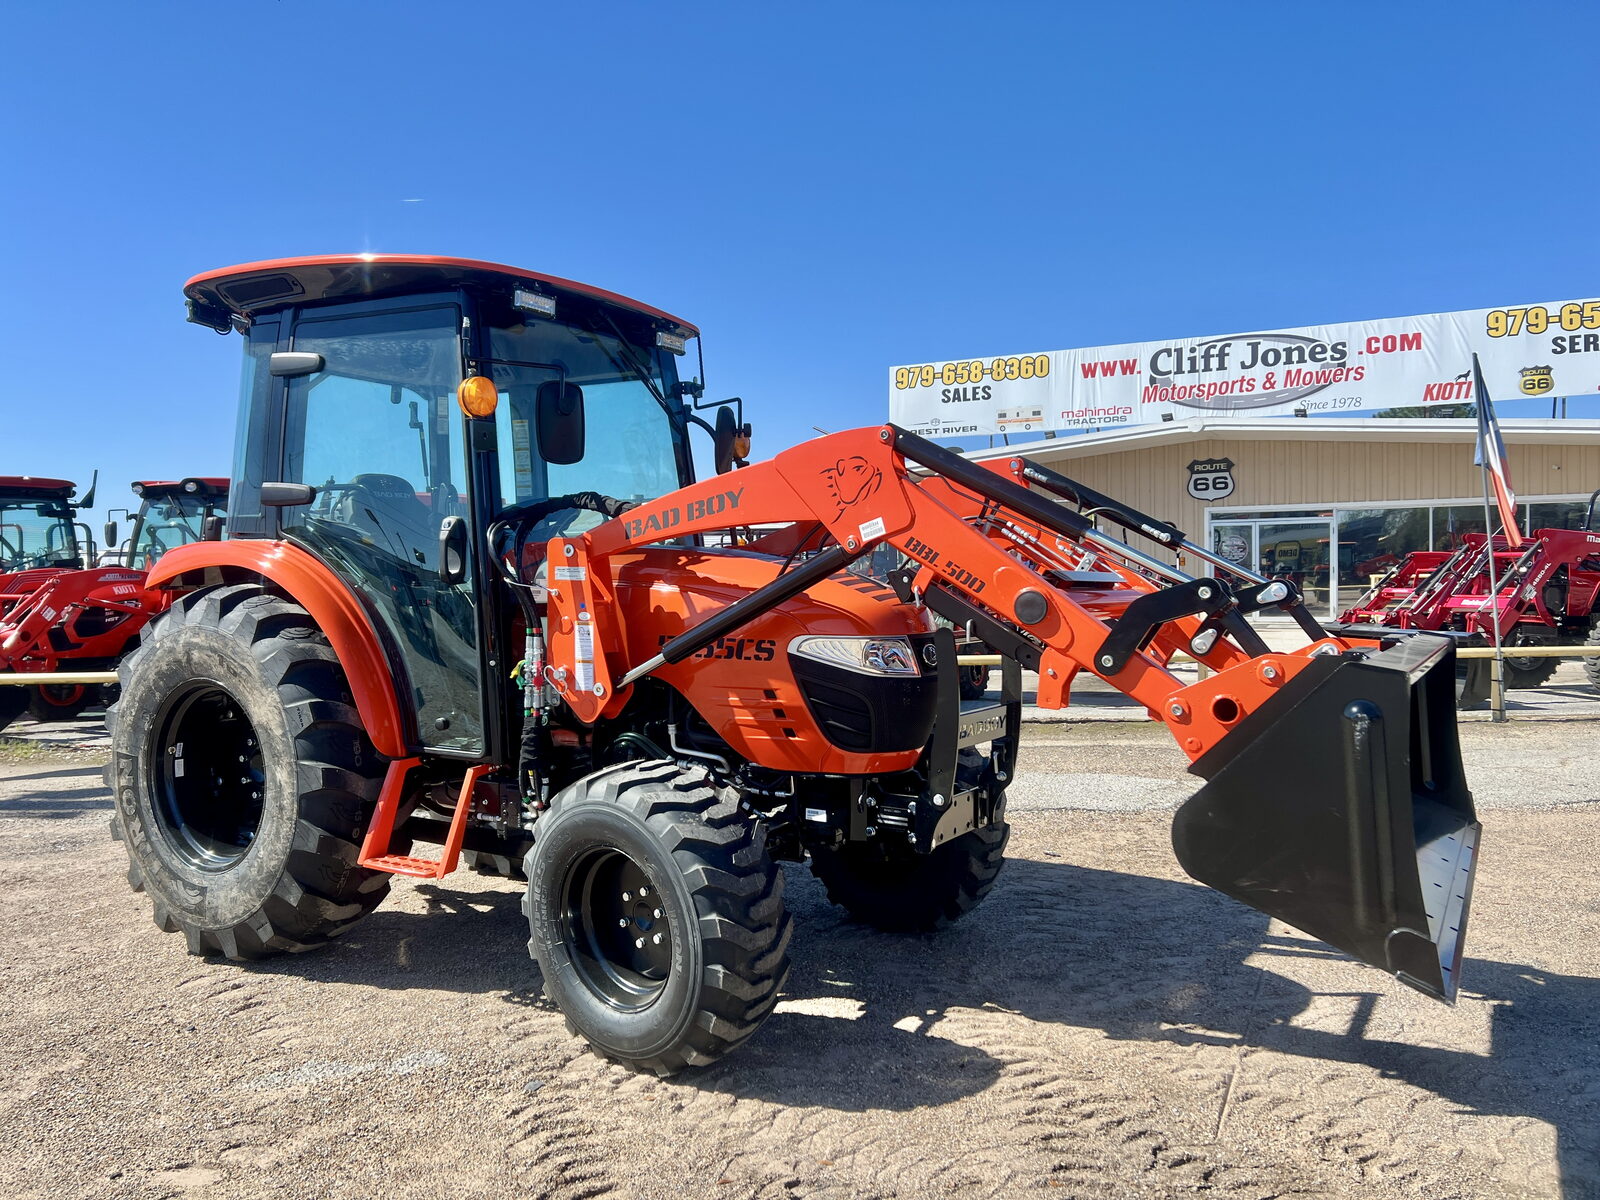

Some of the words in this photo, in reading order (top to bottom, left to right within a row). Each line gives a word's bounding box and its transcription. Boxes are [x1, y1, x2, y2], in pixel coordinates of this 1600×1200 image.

[1358, 333, 1422, 355] .COM
[1149, 343, 1232, 376] Cliff
[1240, 341, 1347, 369] Jones
[895, 355, 1050, 390] 979-658-8360
[1523, 368, 1549, 376] ROUTE
[1142, 376, 1257, 403] Motorsports
[1262, 372, 1277, 390] &
[1284, 366, 1365, 388] Mowers
[1422, 381, 1472, 401] KIOTI
[1523, 378, 1550, 390] 66
[941, 385, 992, 404] SALES
[1300, 399, 1328, 410] Since
[1332, 397, 1362, 409] 1978
[1061, 405, 1132, 418] mahindra
[1067, 414, 1127, 426] TRACTORS
[943, 425, 978, 434] RIVER
[1194, 462, 1228, 471] ROUTE
[1193, 476, 1229, 491] 66
[624, 507, 681, 540] BAD
[687, 487, 744, 521] BOY
[903, 536, 940, 567] BBL
[942, 561, 987, 594] 500
[113, 584, 136, 595] KIOTI
